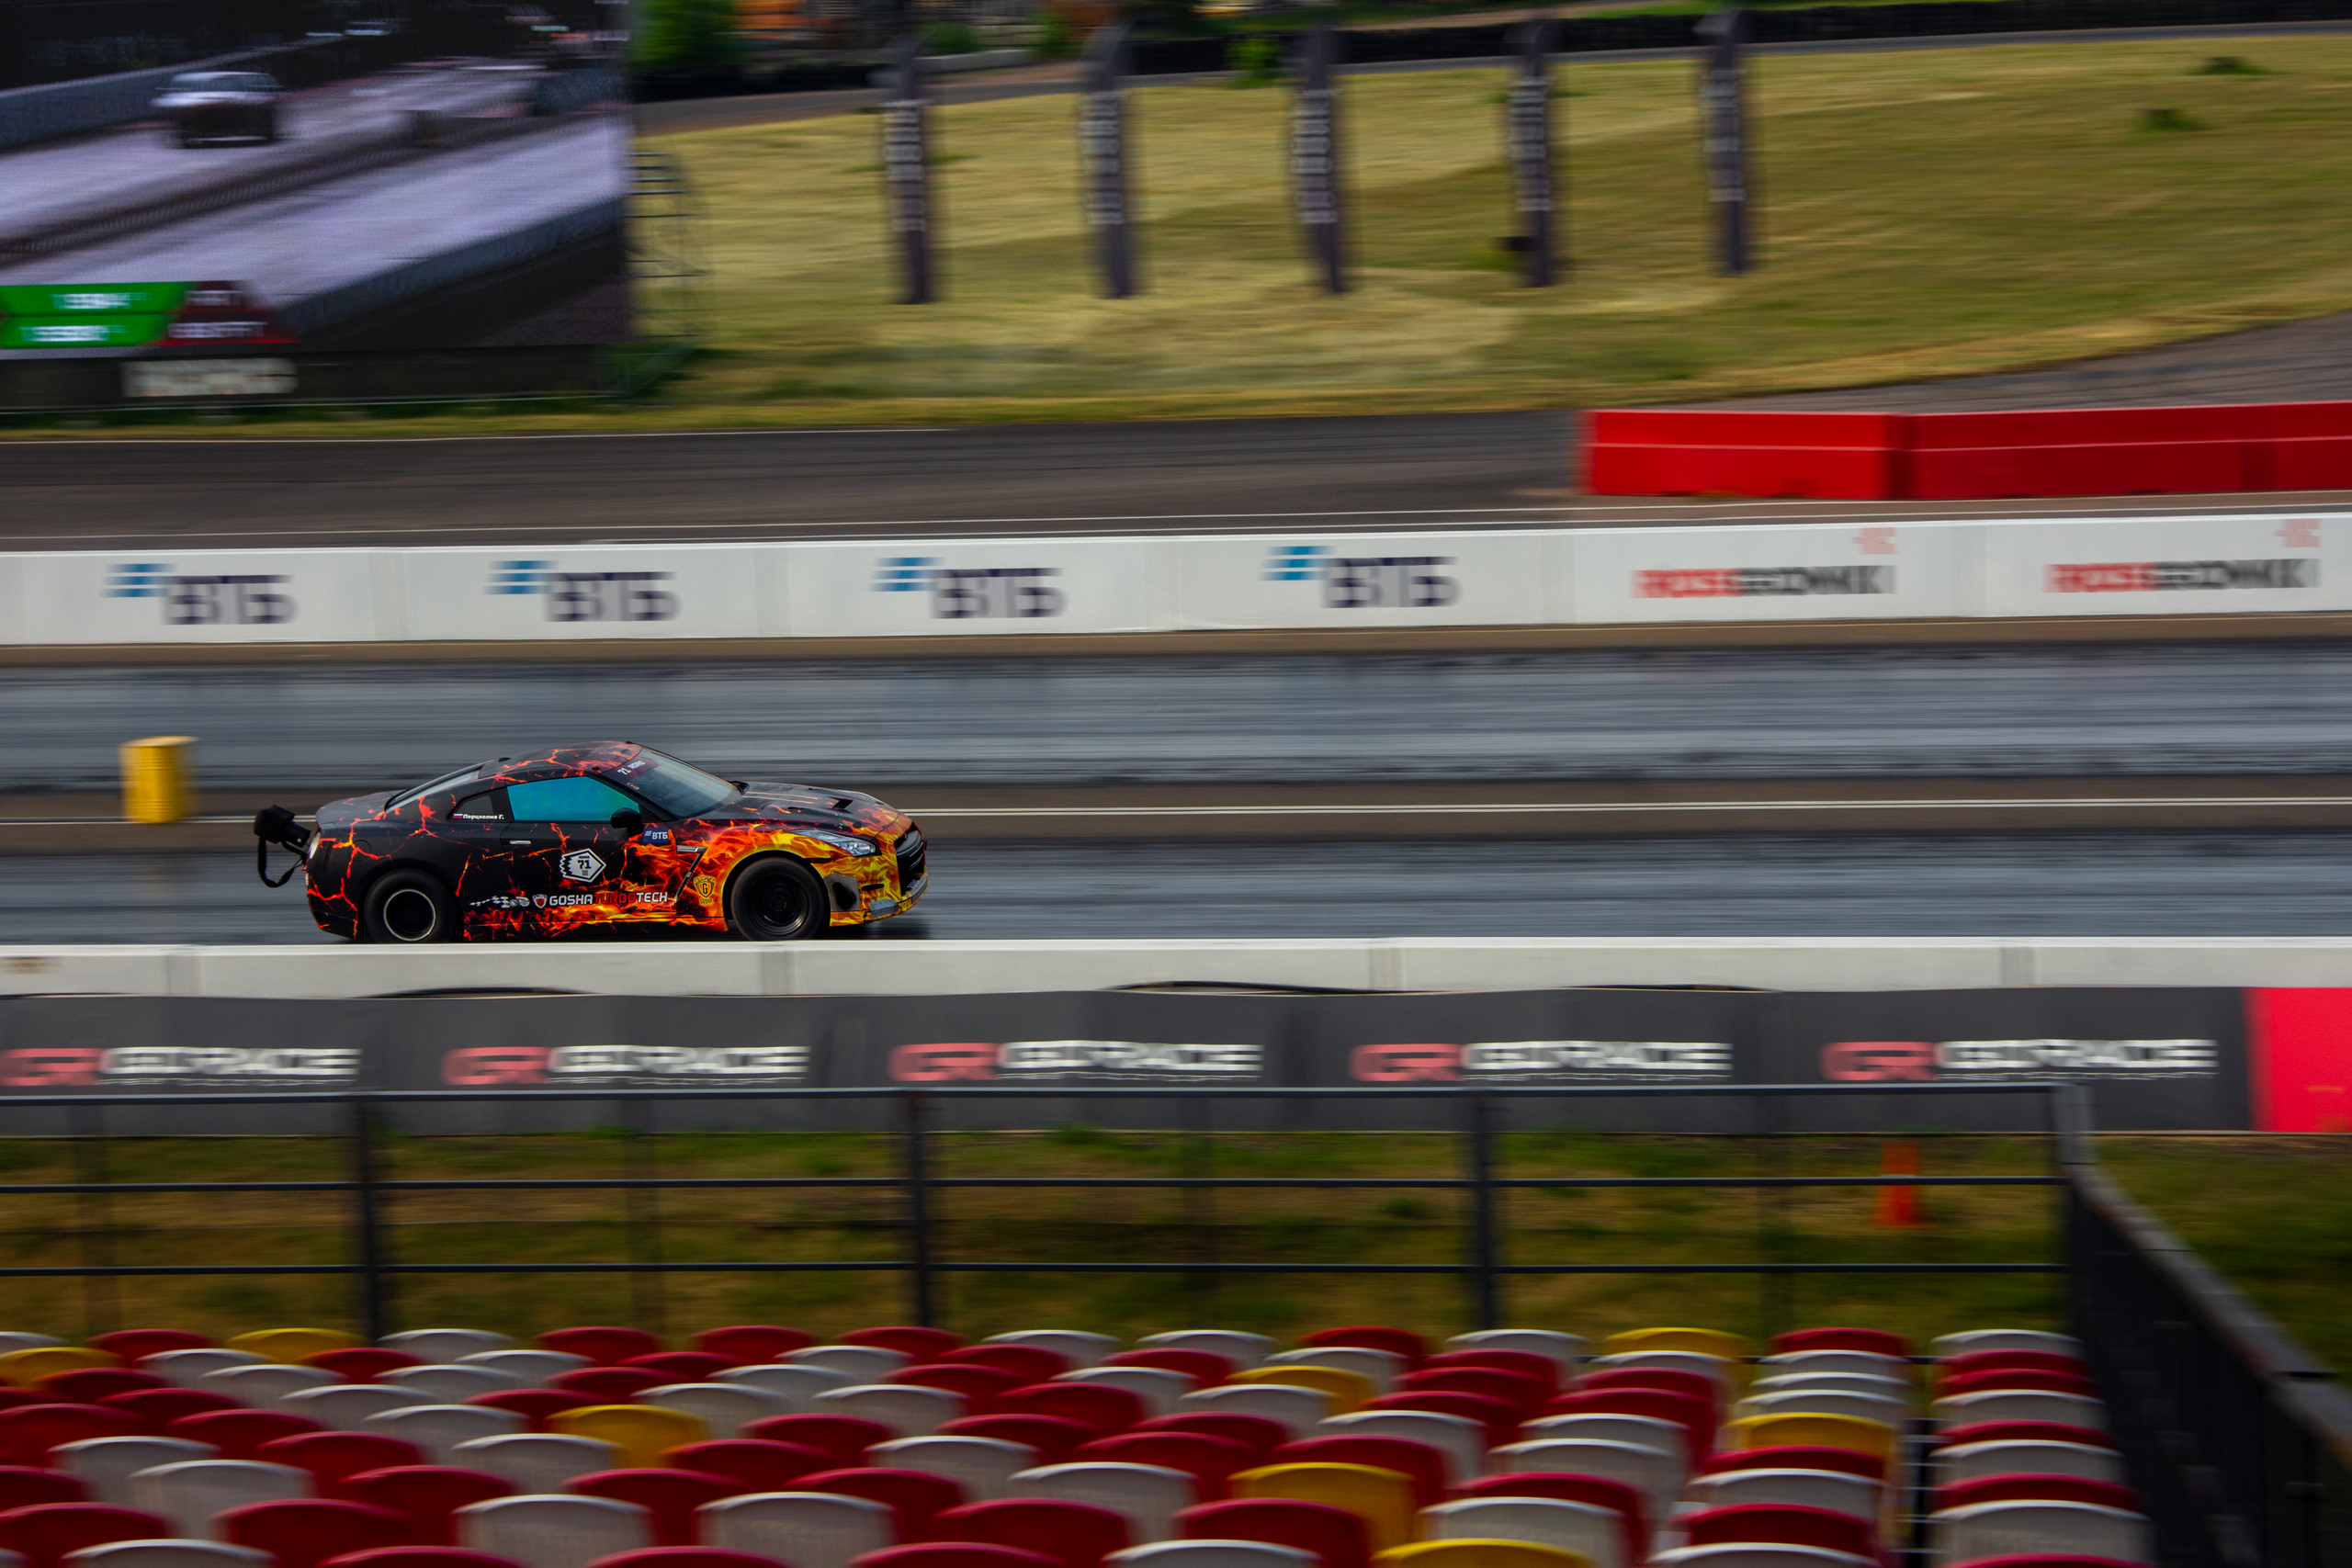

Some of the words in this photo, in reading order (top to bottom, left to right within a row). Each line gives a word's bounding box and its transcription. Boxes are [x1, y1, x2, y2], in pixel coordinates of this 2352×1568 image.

[165, 574, 298, 626] ВТБ
[545, 571, 680, 623] ВТБ
[931, 568, 1066, 619] ВТБ
[1323, 556, 1460, 609] ВТБ
[652, 831, 668, 840] ВТБ
[577, 859, 592, 870] 71
